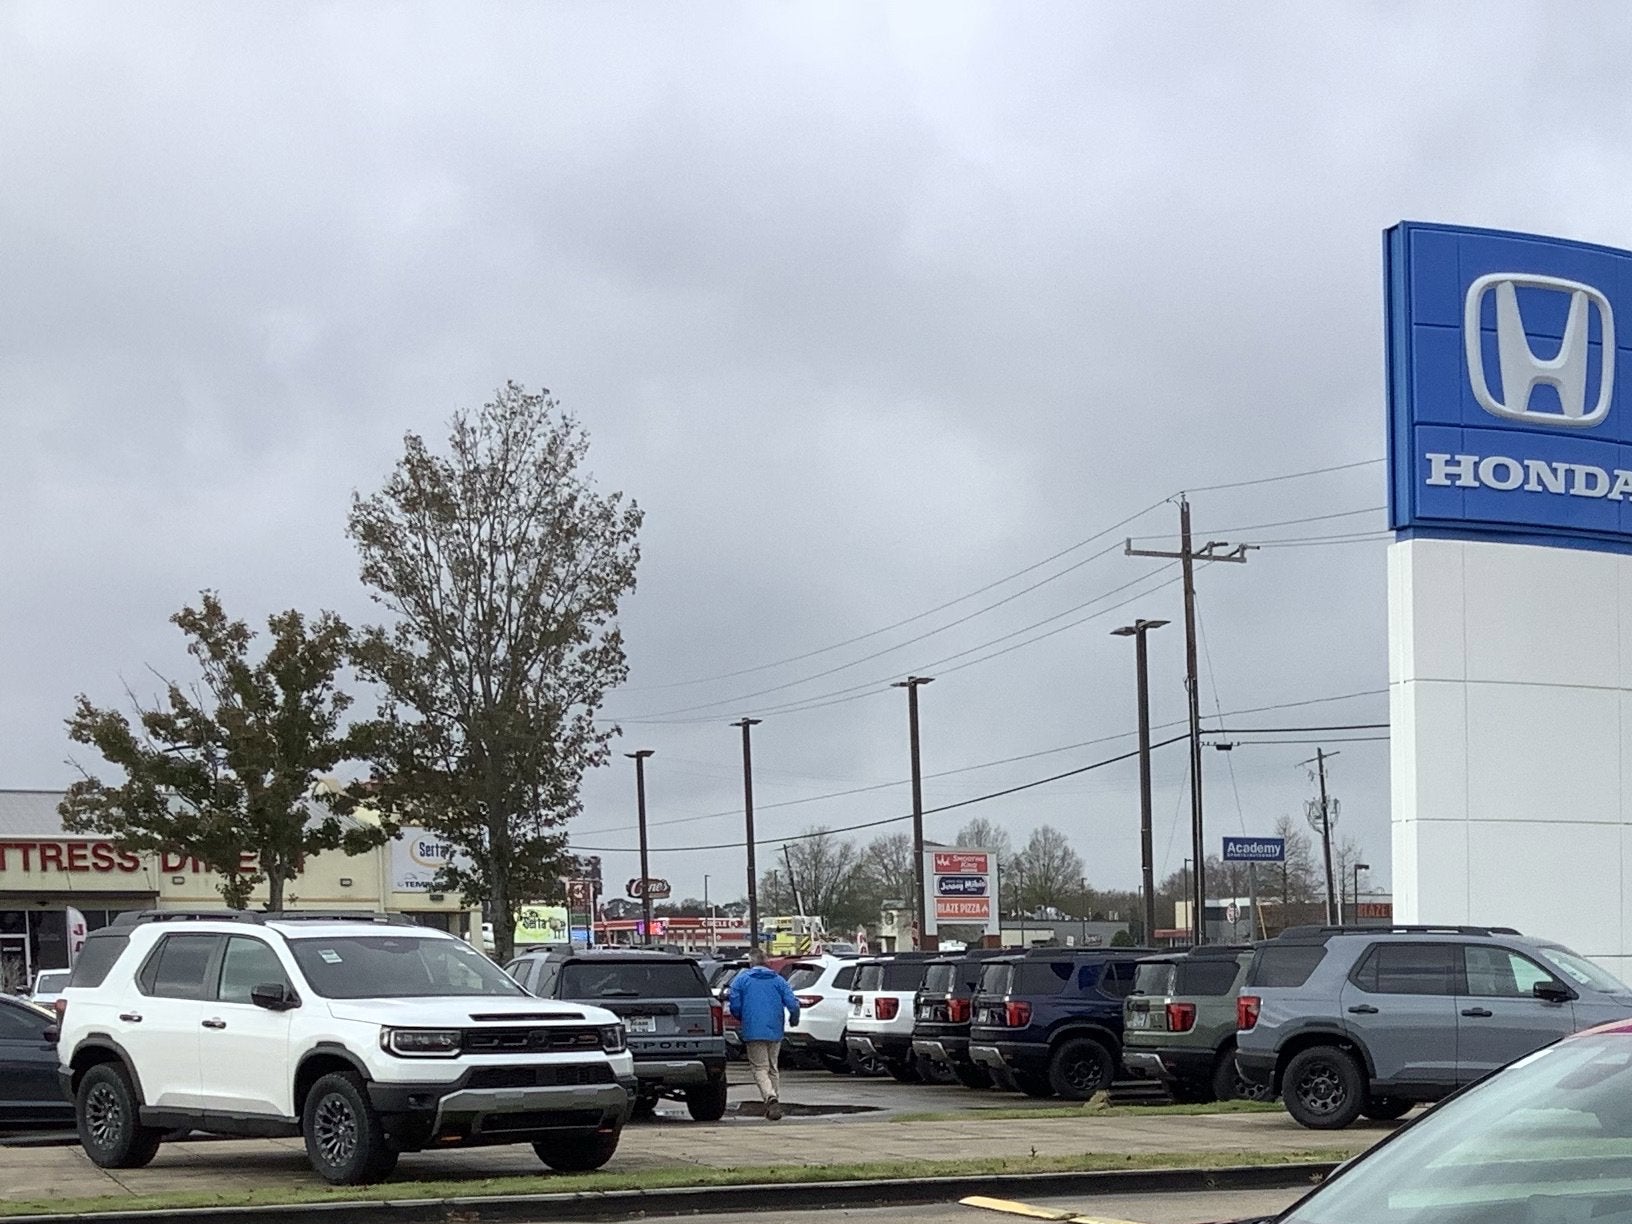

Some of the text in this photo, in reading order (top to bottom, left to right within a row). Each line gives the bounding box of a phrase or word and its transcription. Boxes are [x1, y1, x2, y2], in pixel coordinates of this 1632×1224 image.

[1227, 842, 1281, 856] Academy
[938, 904, 981, 913] BLAZE PIZZA
